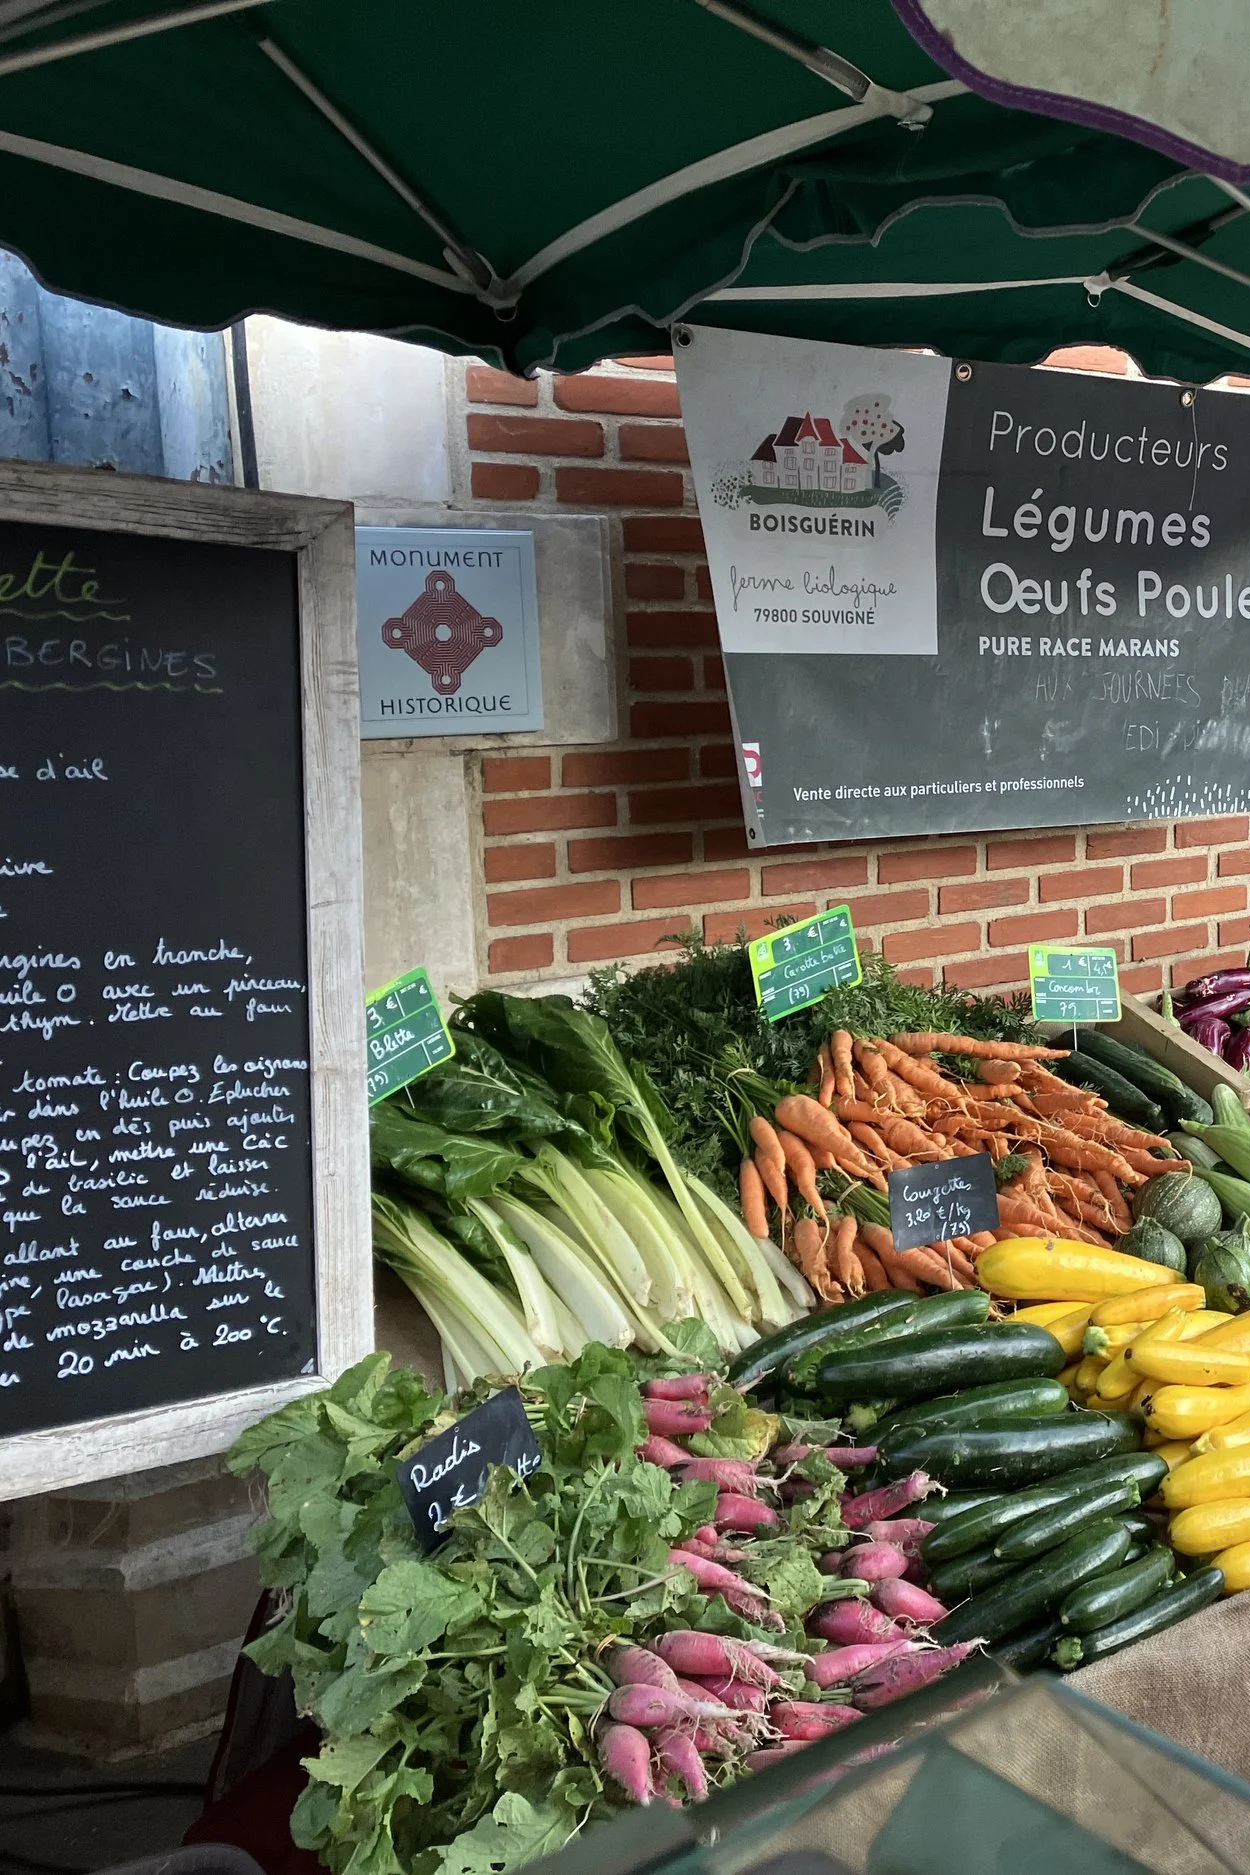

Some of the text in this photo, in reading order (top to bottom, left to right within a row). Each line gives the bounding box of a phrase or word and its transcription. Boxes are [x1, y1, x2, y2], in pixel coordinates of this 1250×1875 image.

[989, 411, 1229, 471] Producteurs
[750, 513, 875, 537] BOISGUÉRIN
[982, 486, 1211, 553] Légumes
[370, 549, 503, 568] MONUMENT
[730, 565, 898, 612] ferme biologique
[980, 562, 1116, 615] Œufs
[753, 606, 875, 625] 79800 SOUVIGNÉ
[979, 637, 1180, 658] PURE RACE MARANS
[380, 695, 512, 715] HISTORIQUE
[793, 775, 1085, 802] Vente directe aux particuliers et professionnels
[103, 951, 136, 970] en
[102, 984, 155, 1000] avec
[171, 983, 211, 996] un
[189, 1006, 224, 1017] au
[369, 1027, 417, 1061] Blette
[128, 1061, 201, 1084] Coupez
[213, 1054, 238, 1074] les
[75, 1129, 102, 1142] en
[168, 1111, 211, 1138] puis
[108, 1140, 177, 1164] mettre
[188, 1136, 230, 1154] une
[22, 1180, 51, 1197] de
[67, 1172, 150, 1193] basilic
[170, 1161, 196, 1180] et
[3, 1211, 42, 1233] que
[61, 1195, 87, 1216] la
[110, 1193, 173, 1209] sauce
[3, 1236, 80, 1266] allant
[103, 1235, 137, 1250] au
[53, 1268, 103, 1285] une
[121, 1248, 196, 1272] couche
[211, 1241, 244, 1258] de
[251, 1234, 300, 1251] sauce
[3, 1279, 286, 1352] de mozzarella sur le
[57, 1350, 94, 1379] 20
[104, 1339, 161, 1367] min
[180, 1331, 200, 1351] à
[212, 1324, 252, 1346] 200
[410, 1435, 481, 1493] Radis
